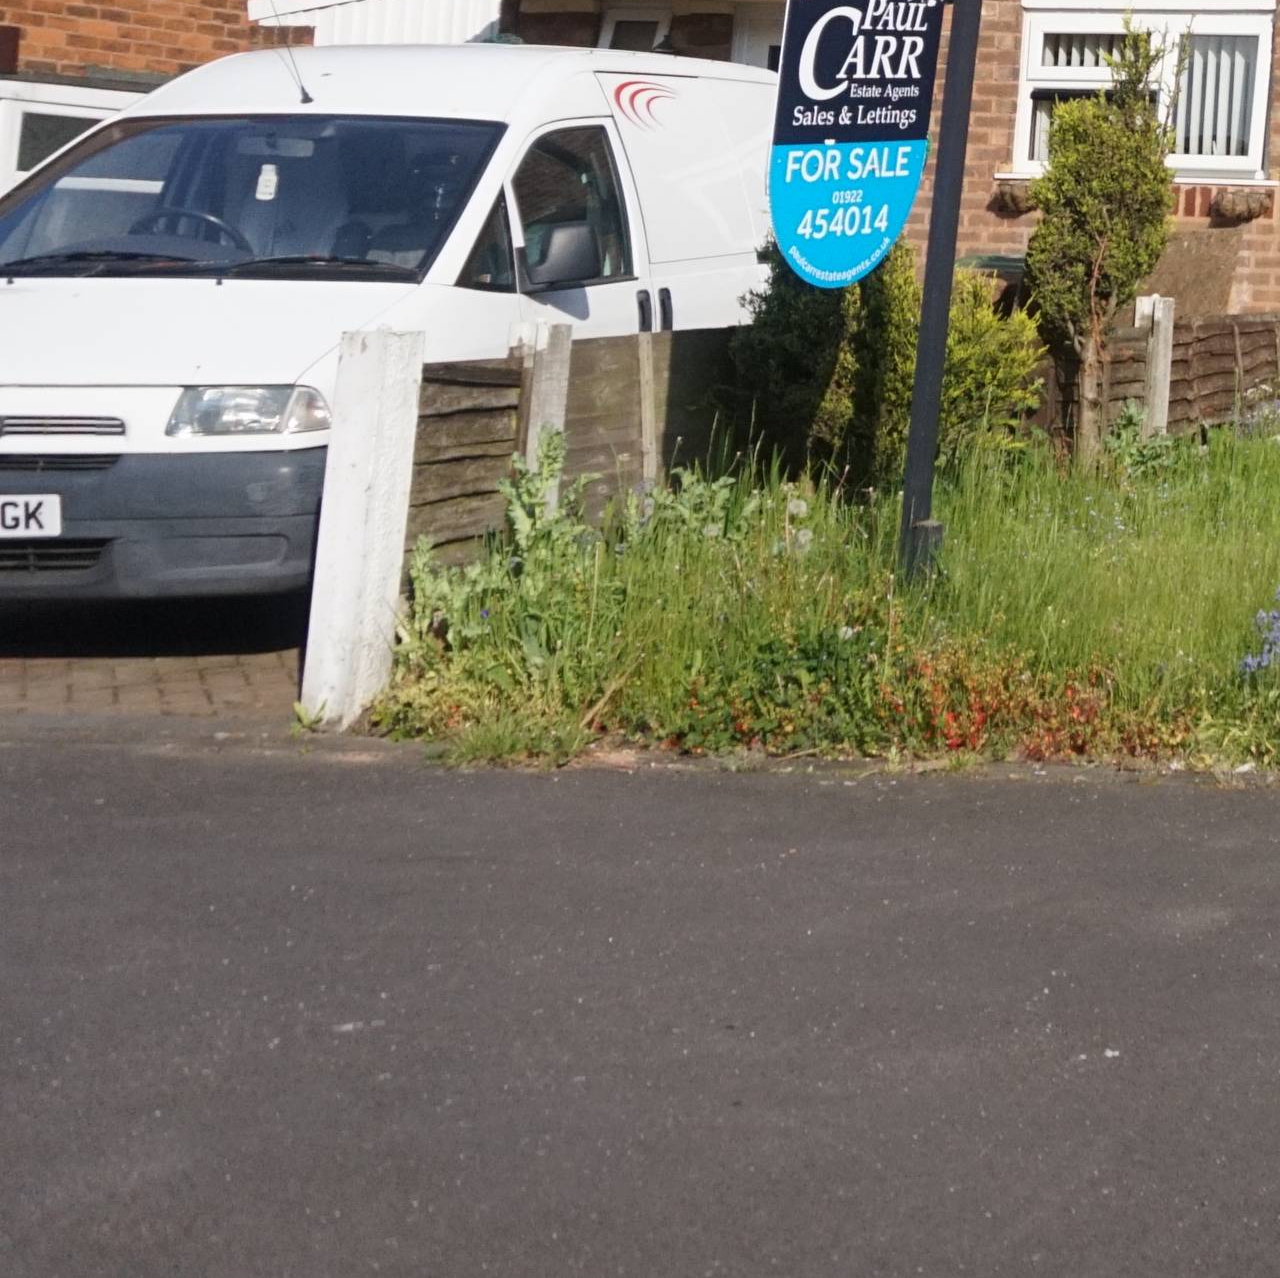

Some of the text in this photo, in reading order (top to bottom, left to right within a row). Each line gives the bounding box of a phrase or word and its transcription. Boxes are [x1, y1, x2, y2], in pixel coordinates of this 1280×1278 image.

[799, 6, 924, 101] CARR
[850, 83, 919, 101] Estate Agents
[792, 104, 917, 129] Sales & Lettings
[785, 146, 912, 183] FOR SALE
[832, 189, 863, 204] 01922
[797, 204, 889, 239] 454014
[0, 501, 44, 530] GK
